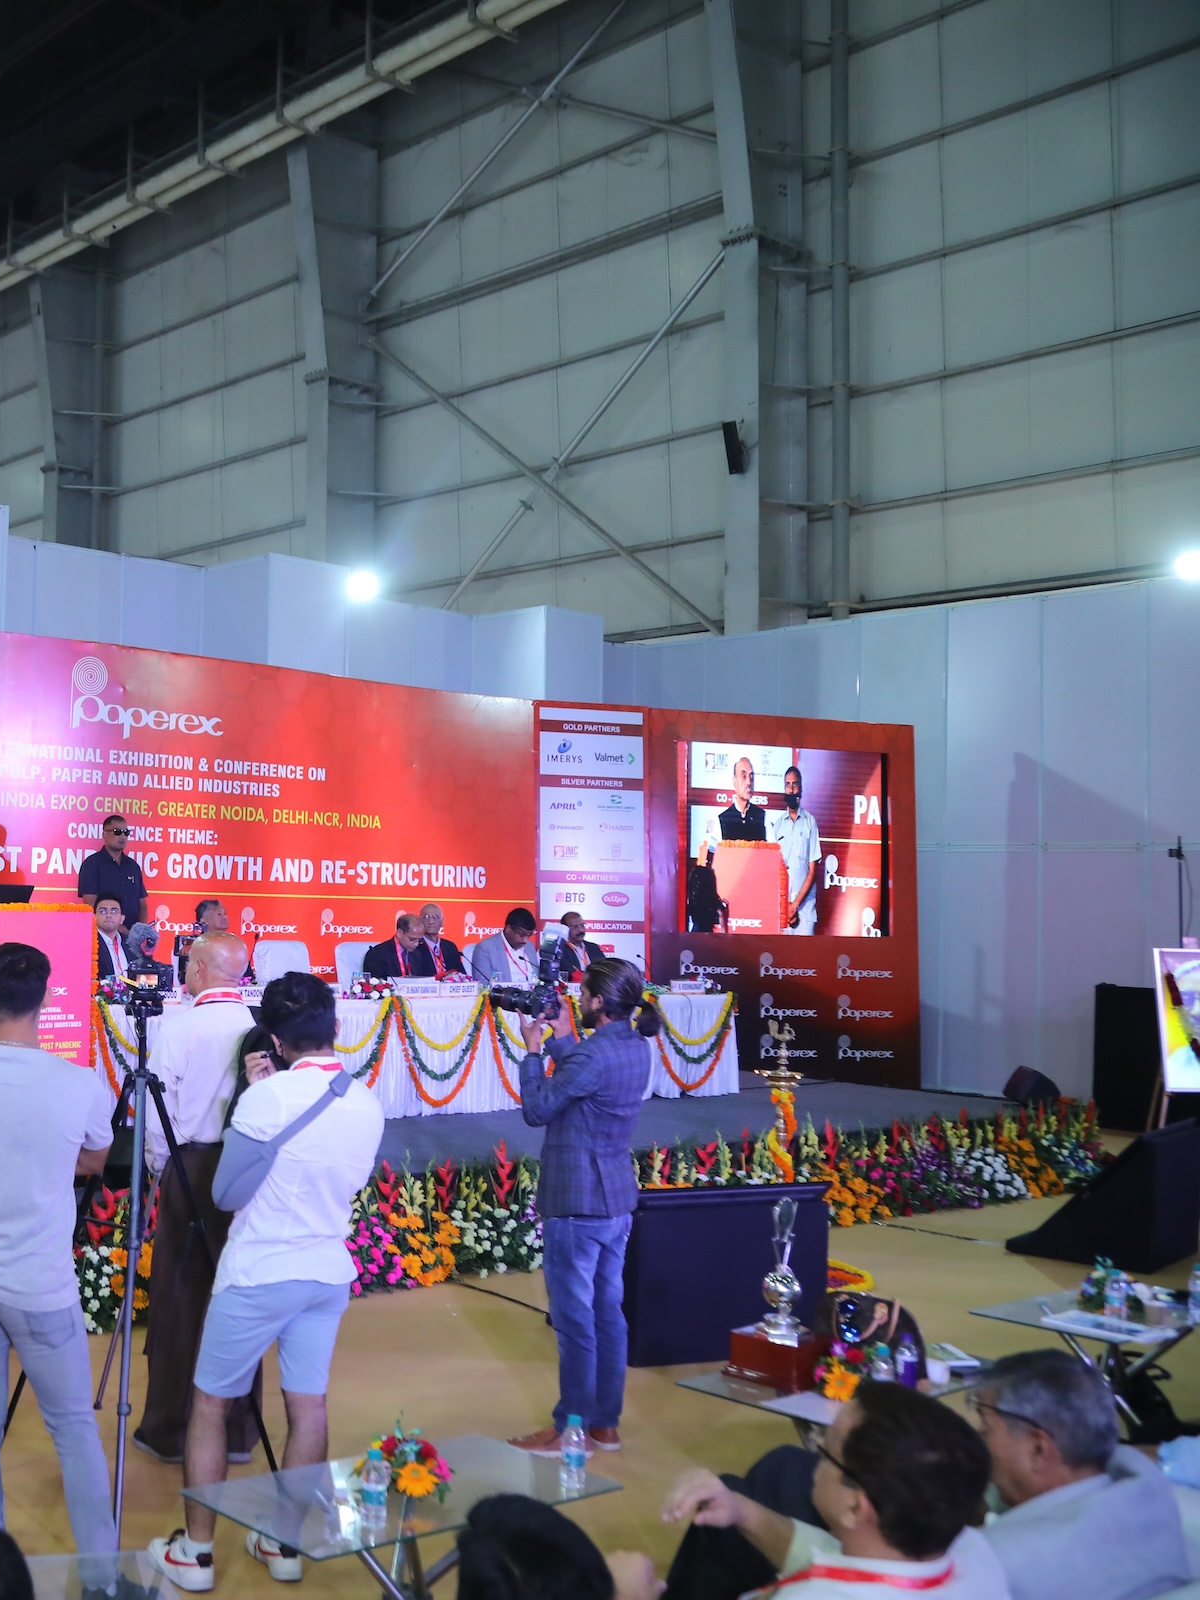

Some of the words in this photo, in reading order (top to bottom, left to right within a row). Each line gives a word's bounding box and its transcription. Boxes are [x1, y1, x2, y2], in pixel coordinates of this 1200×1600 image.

[71, 695, 224, 739] Paperex
[563, 723, 583, 731] GOLD
[584, 724, 620, 733] PARTNERS
[547, 754, 583, 763] IMERYS
[594, 752, 624, 763] Valmet
[109, 750, 193, 770] EXHIBITION
[198, 758, 209, 772] &
[213, 759, 304, 780] CONFERENCE
[308, 767, 326, 782] ON
[51, 767, 102, 784] PAPER
[107, 771, 138, 787] AND
[143, 773, 193, 791] ALLIED
[198, 777, 280, 797] INDUSTRIES
[561, 778, 585, 786] SILVER
[586, 779, 623, 788] PARTNERS
[716, 793, 728, 803] CO
[0, 791, 46, 809] INDIA
[50, 794, 89, 812] EXPO
[93, 797, 152, 818] CENTRE,
[157, 801, 217, 820] GREATER
[220, 805, 269, 825] NOIDA,
[273, 810, 343, 830] DELHI-NCR,
[347, 813, 381, 829] INDIA
[550, 802, 577, 810] APRIL
[67, 822, 163, 842] CONENCE
[168, 828, 218, 846] THEME:
[565, 846, 579, 856] JMC
[31, 847, 159, 878] PANIC
[167, 855, 263, 883] GROWTH
[270, 857, 314, 884] AND
[321, 860, 487, 889] RE-STRUCTURING
[582, 874, 619, 882] PARTNERS
[565, 892, 586, 903] BTG
[241, 921, 298, 936] Paperex
[320, 922, 374, 937] Paperex
[760, 964, 817, 979] Paperex
[837, 967, 893, 981] Paperex
[450, 985, 461, 993] CHIEF
[462, 984, 475, 993] GUEST
[760, 1006, 818, 1020] Paperex
[838, 1007, 894, 1021] Paperex
[40, 1042, 54, 1050] POST
[55, 1041, 82, 1049] PANDEMIC
[760, 1046, 818, 1059] Paerex
